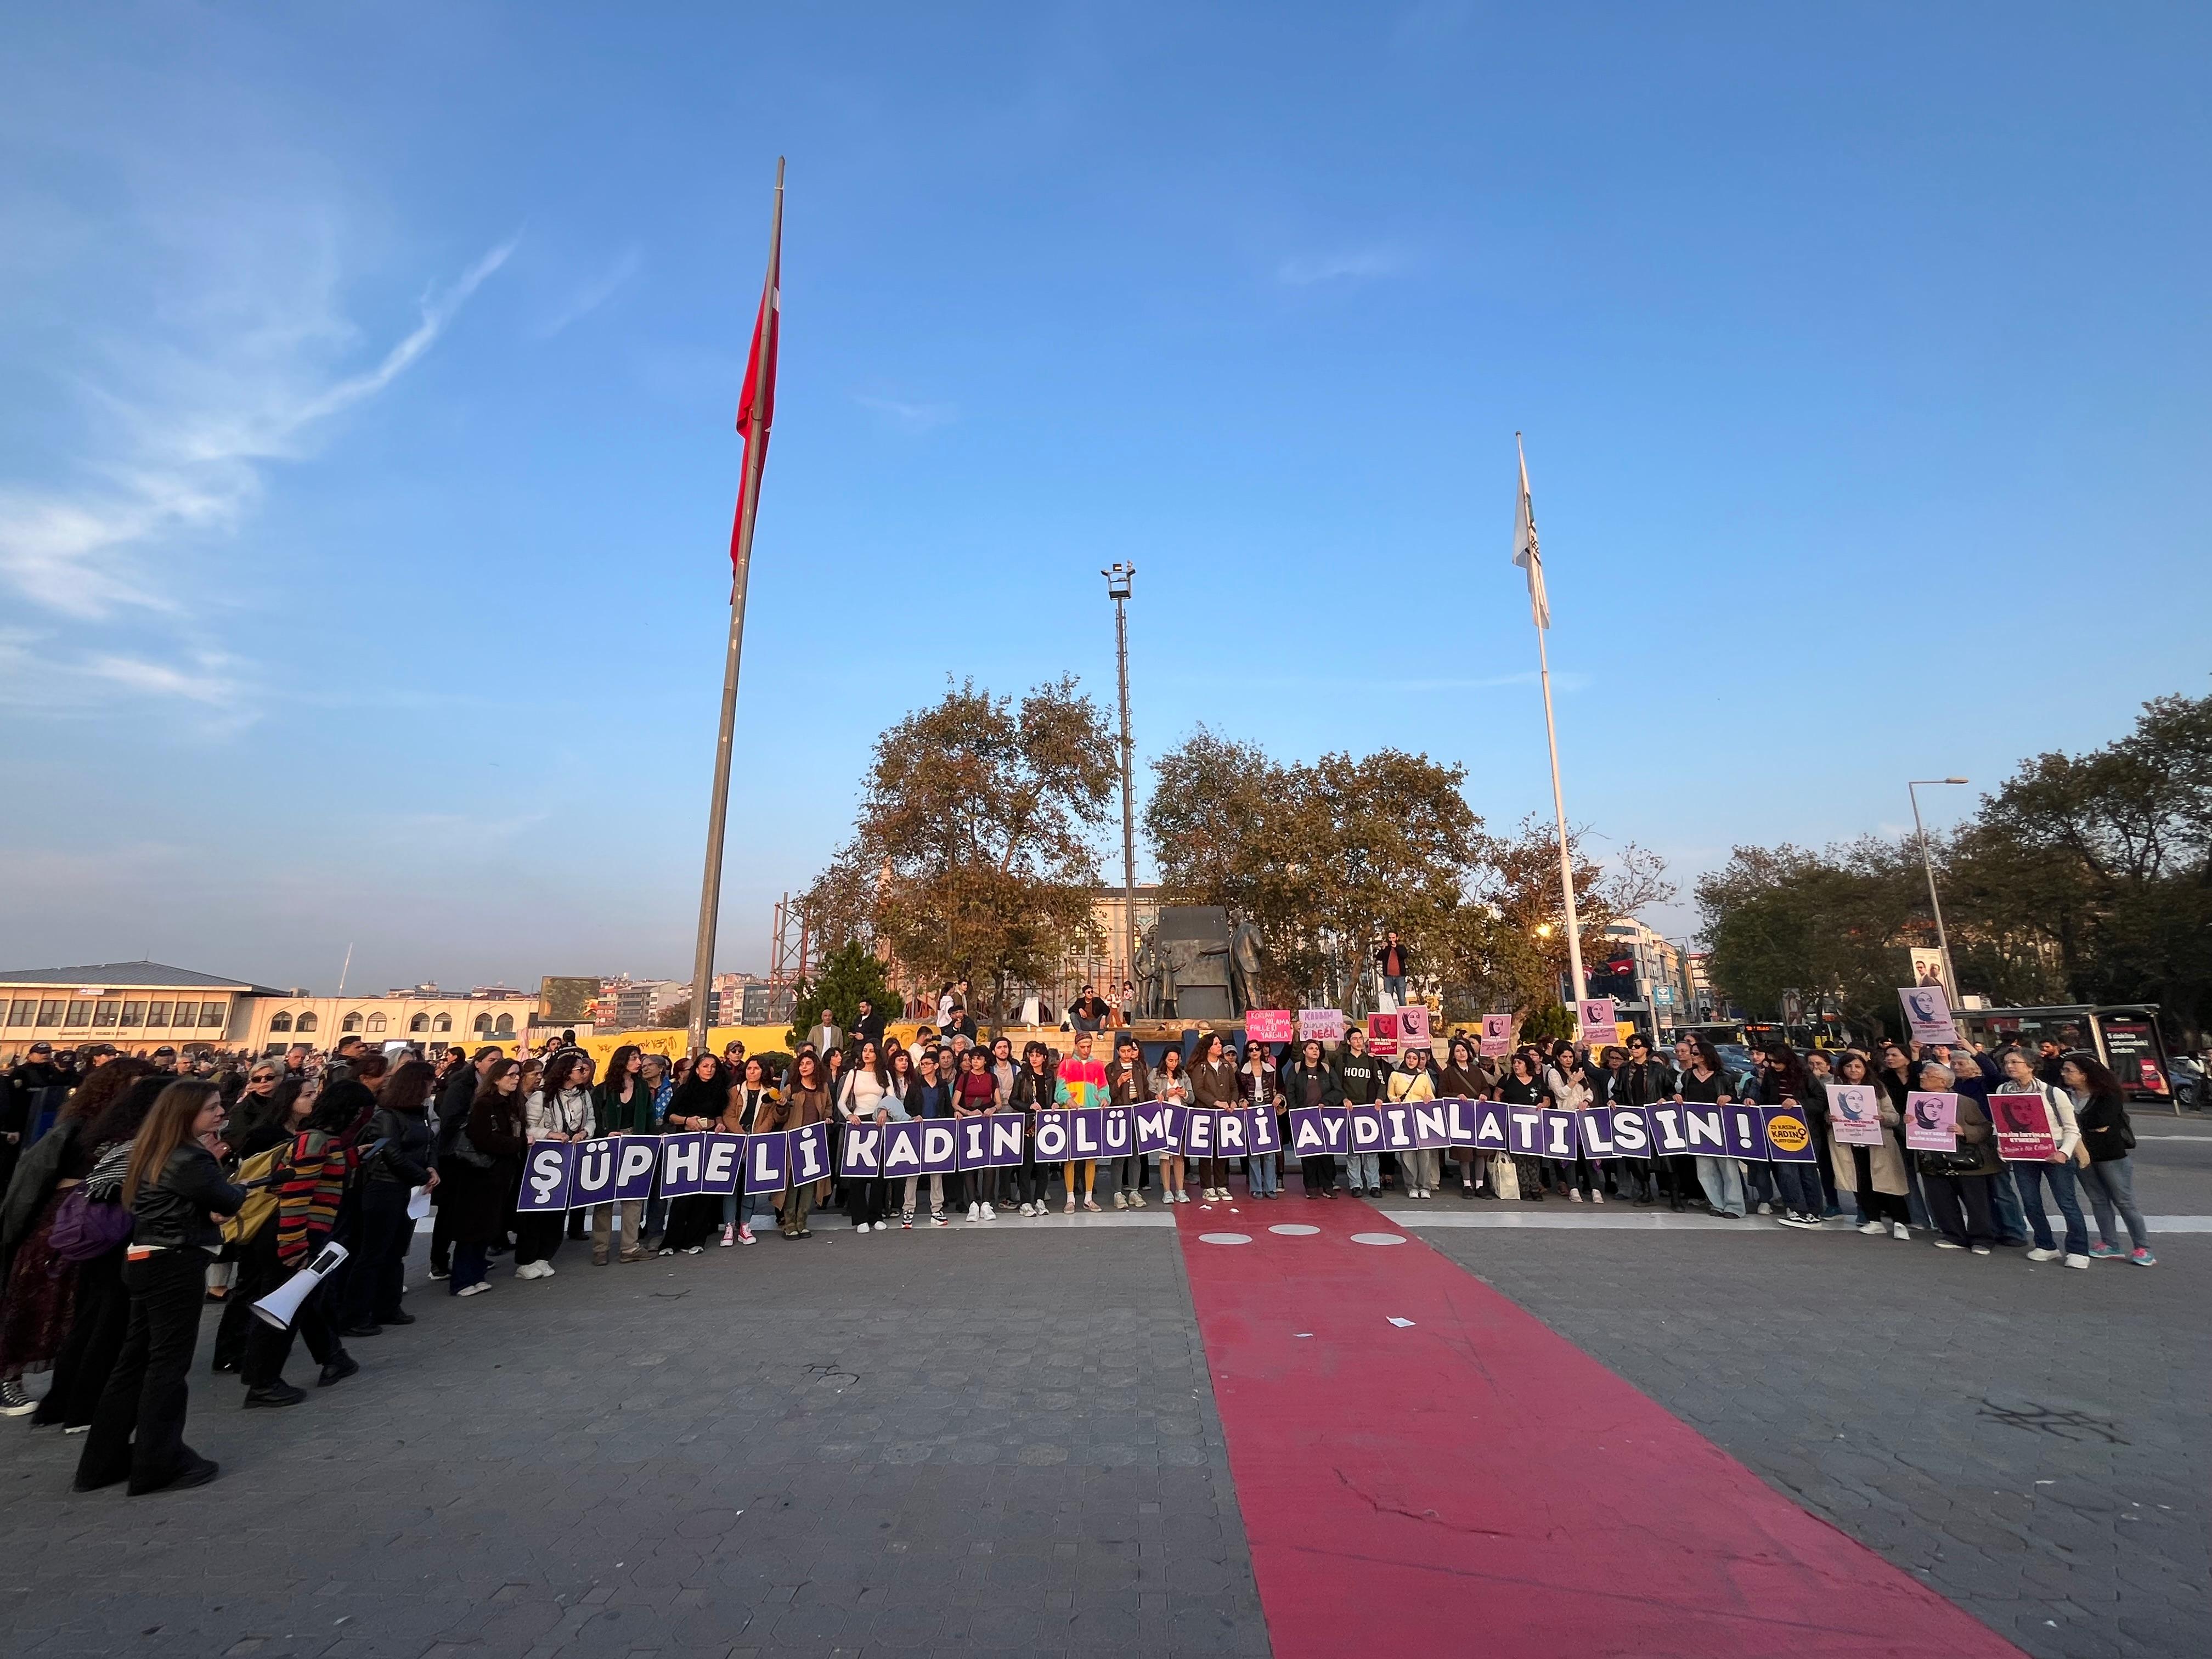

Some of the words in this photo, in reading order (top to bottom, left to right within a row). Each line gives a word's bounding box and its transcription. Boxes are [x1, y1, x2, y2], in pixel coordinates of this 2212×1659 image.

[1344, 1067, 1370, 1079] HOOD
[530, 1128, 820, 1204] ŞÜPHELİ
[846, 1121, 1022, 1167] KADIN
[1037, 1104, 1270, 1155] ÖLÜMLERİ
[1296, 1104, 1752, 1154] AYDINLATILSIN!
